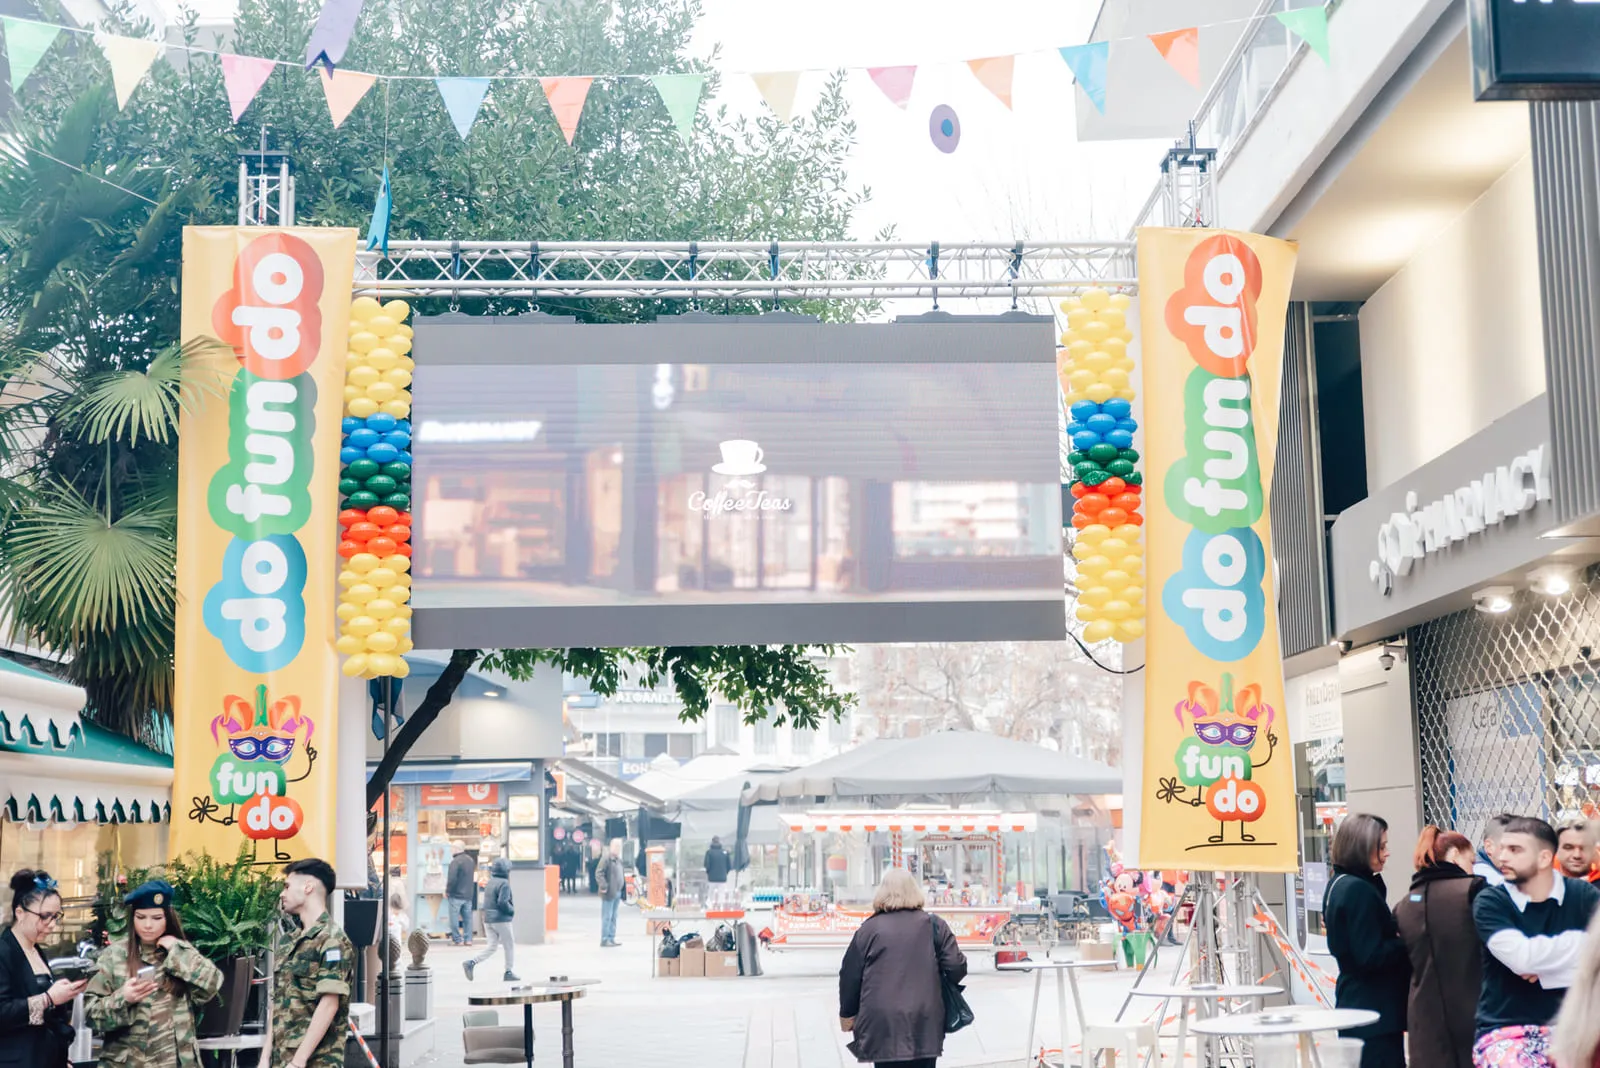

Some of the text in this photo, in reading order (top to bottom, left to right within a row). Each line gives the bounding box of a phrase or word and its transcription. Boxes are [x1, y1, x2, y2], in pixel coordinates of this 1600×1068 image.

[220, 253, 304, 652] do fun do
[1182, 253, 1249, 642] do fun do
[216, 763, 278, 796] fun
[1183, 745, 1245, 780] fun
[246, 797, 295, 831] do
[1213, 780, 1259, 814] do
